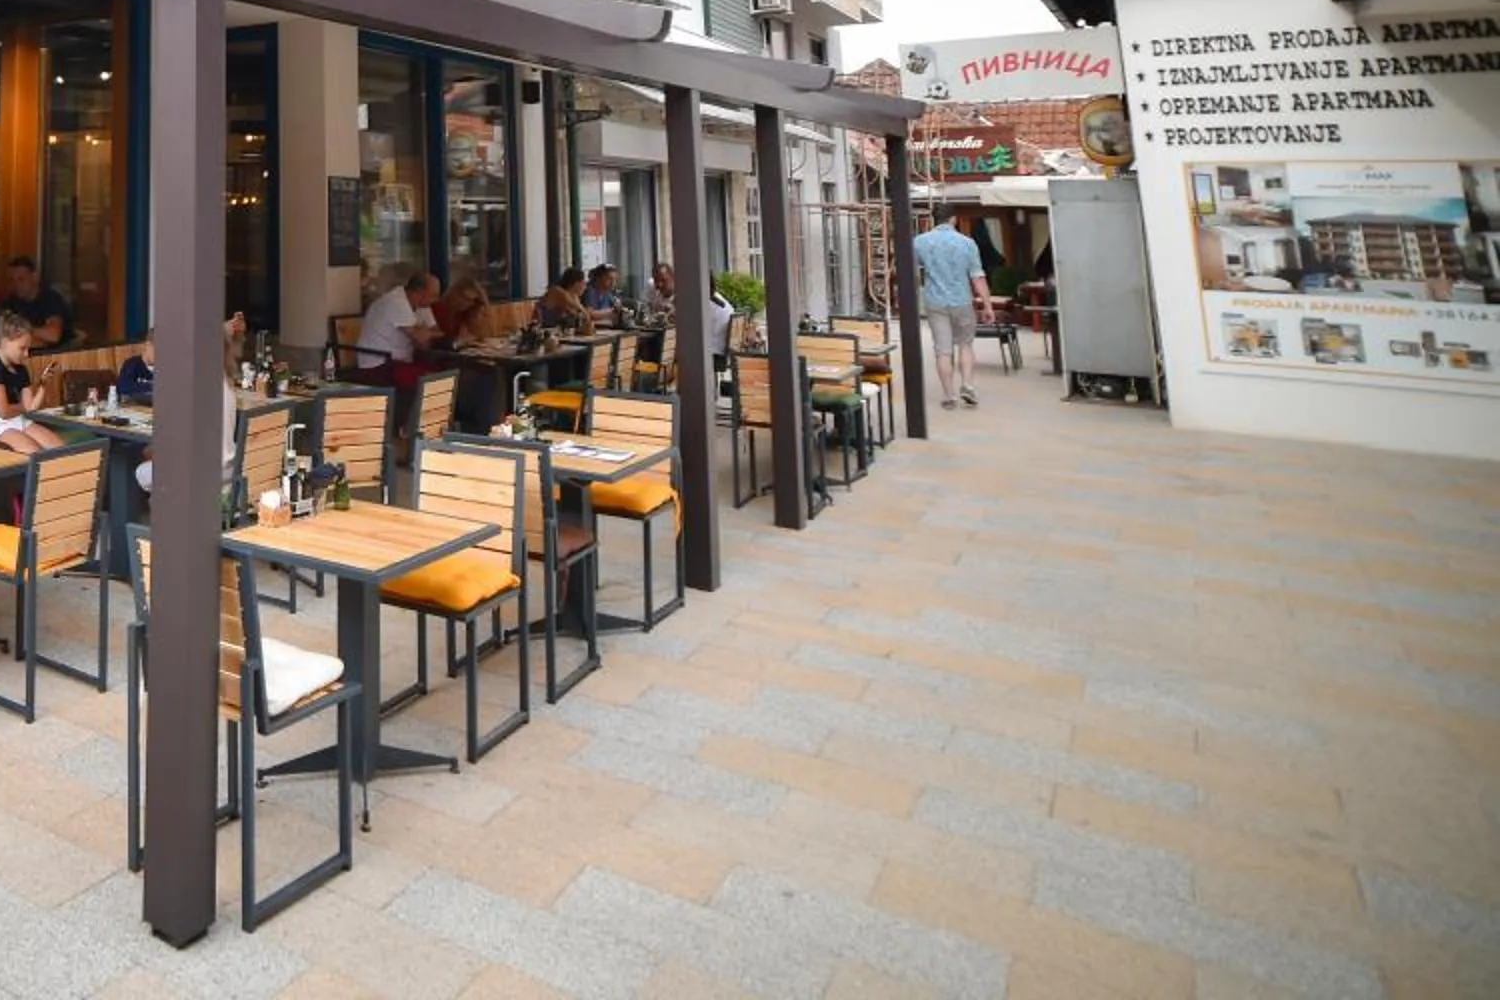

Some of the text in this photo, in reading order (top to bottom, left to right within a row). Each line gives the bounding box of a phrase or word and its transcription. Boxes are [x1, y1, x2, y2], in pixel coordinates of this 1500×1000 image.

[1151, 34, 1255, 56] DIREKTNA
[1268, 26, 1371, 49] PRODAJA
[960, 50, 1111, 84] ПИВНИЦА
[1157, 51, 1500, 86] IZNAJMLJIVANJE APARTMAN
[1159, 89, 1435, 116] OPREMANJE APARTMANA
[1164, 124, 1342, 145] PROJEKTOVANJE
